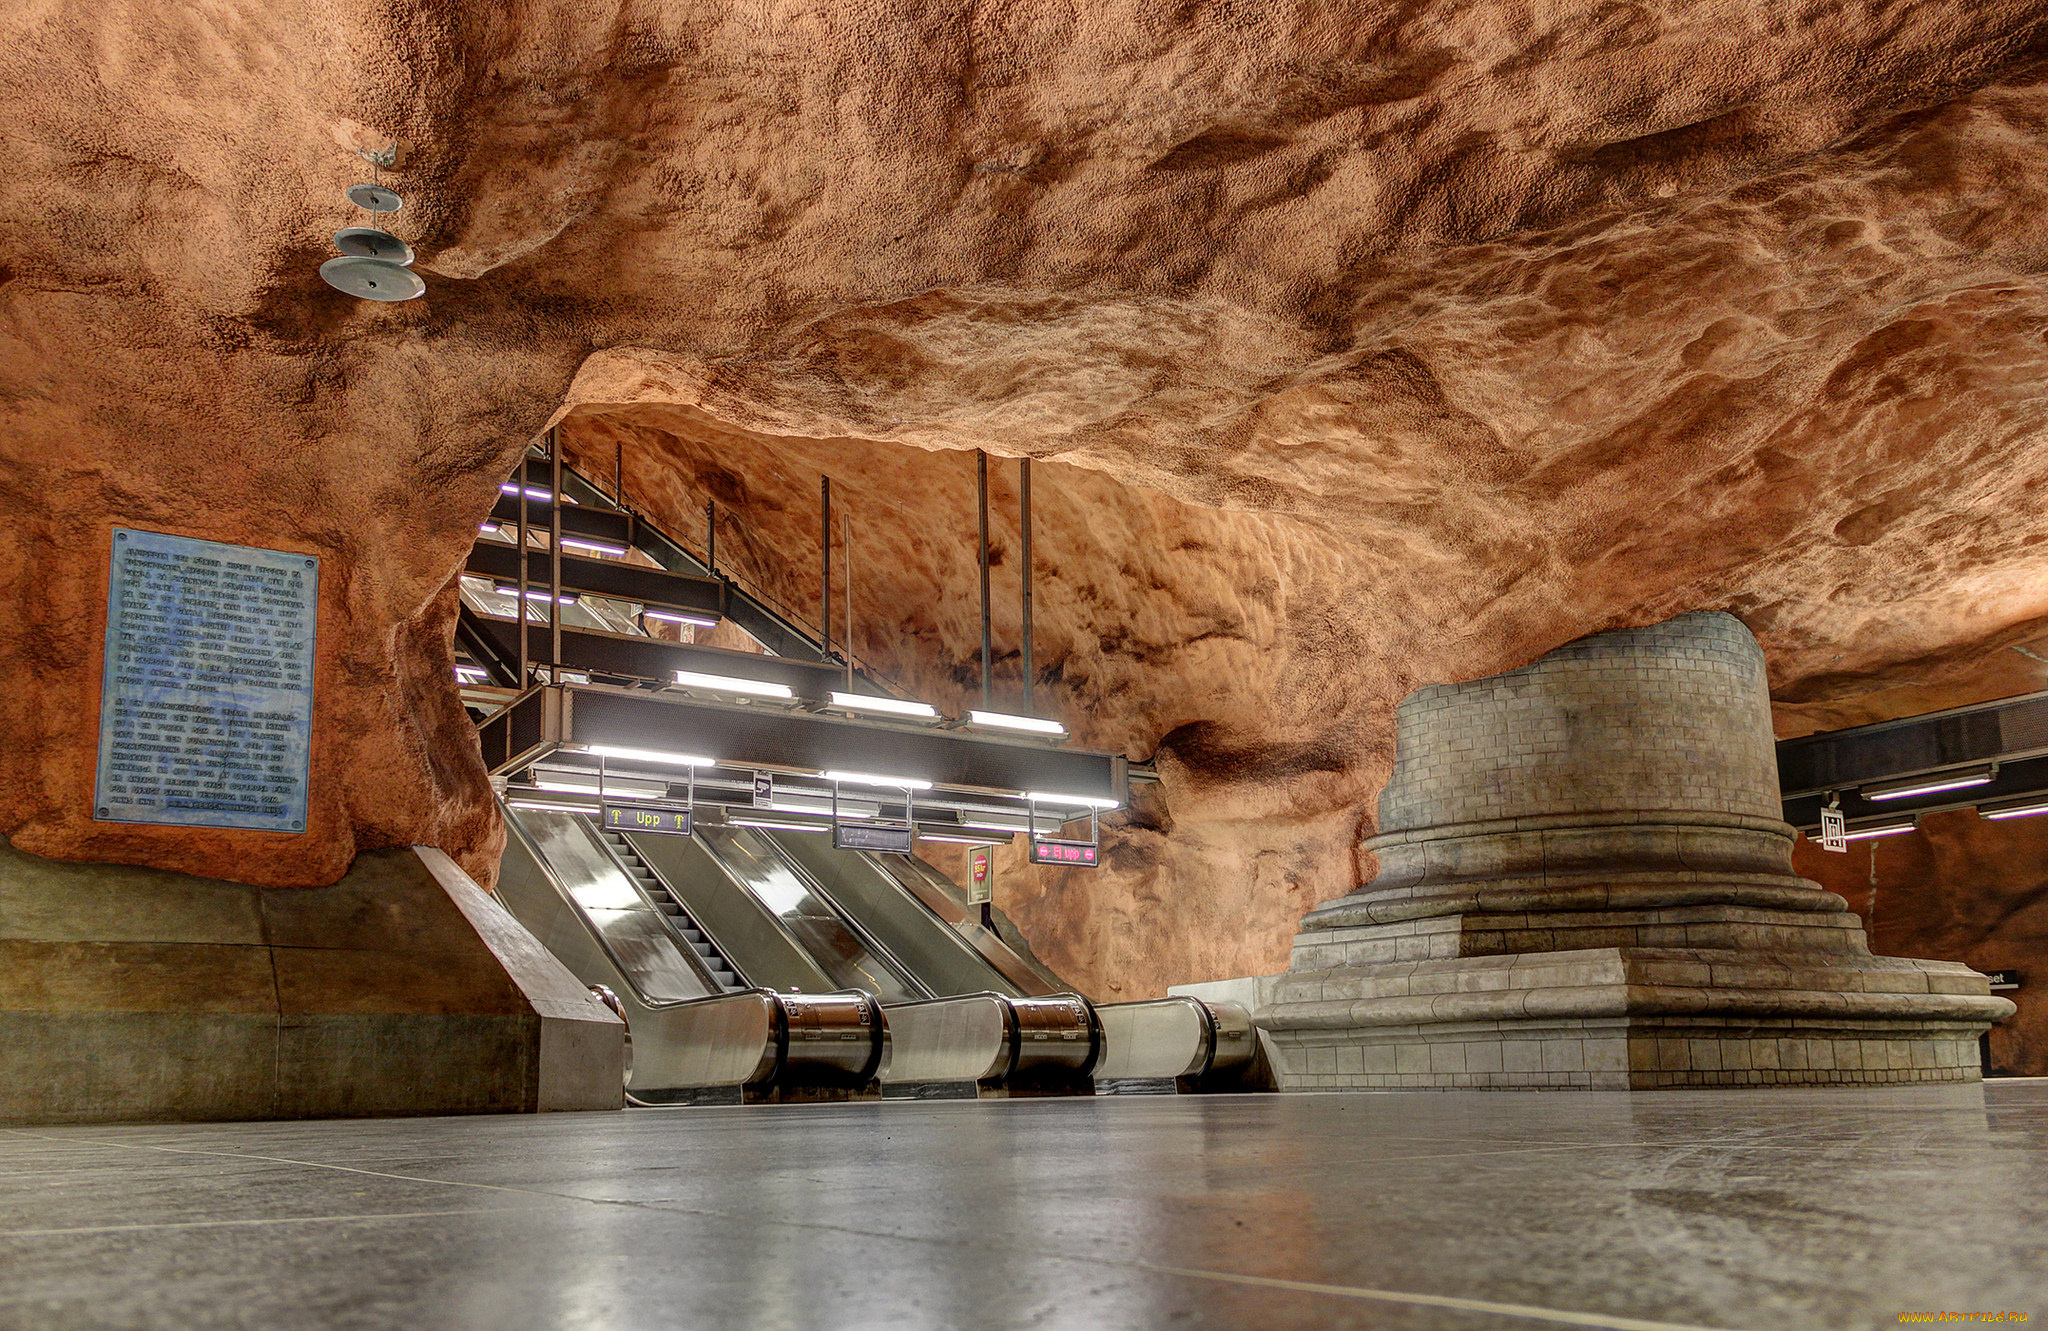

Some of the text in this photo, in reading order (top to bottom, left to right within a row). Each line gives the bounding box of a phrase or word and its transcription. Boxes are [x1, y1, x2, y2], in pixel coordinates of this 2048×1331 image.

[636, 811, 661, 827] Upp
[1053, 845, 1081, 861] Ej upp
